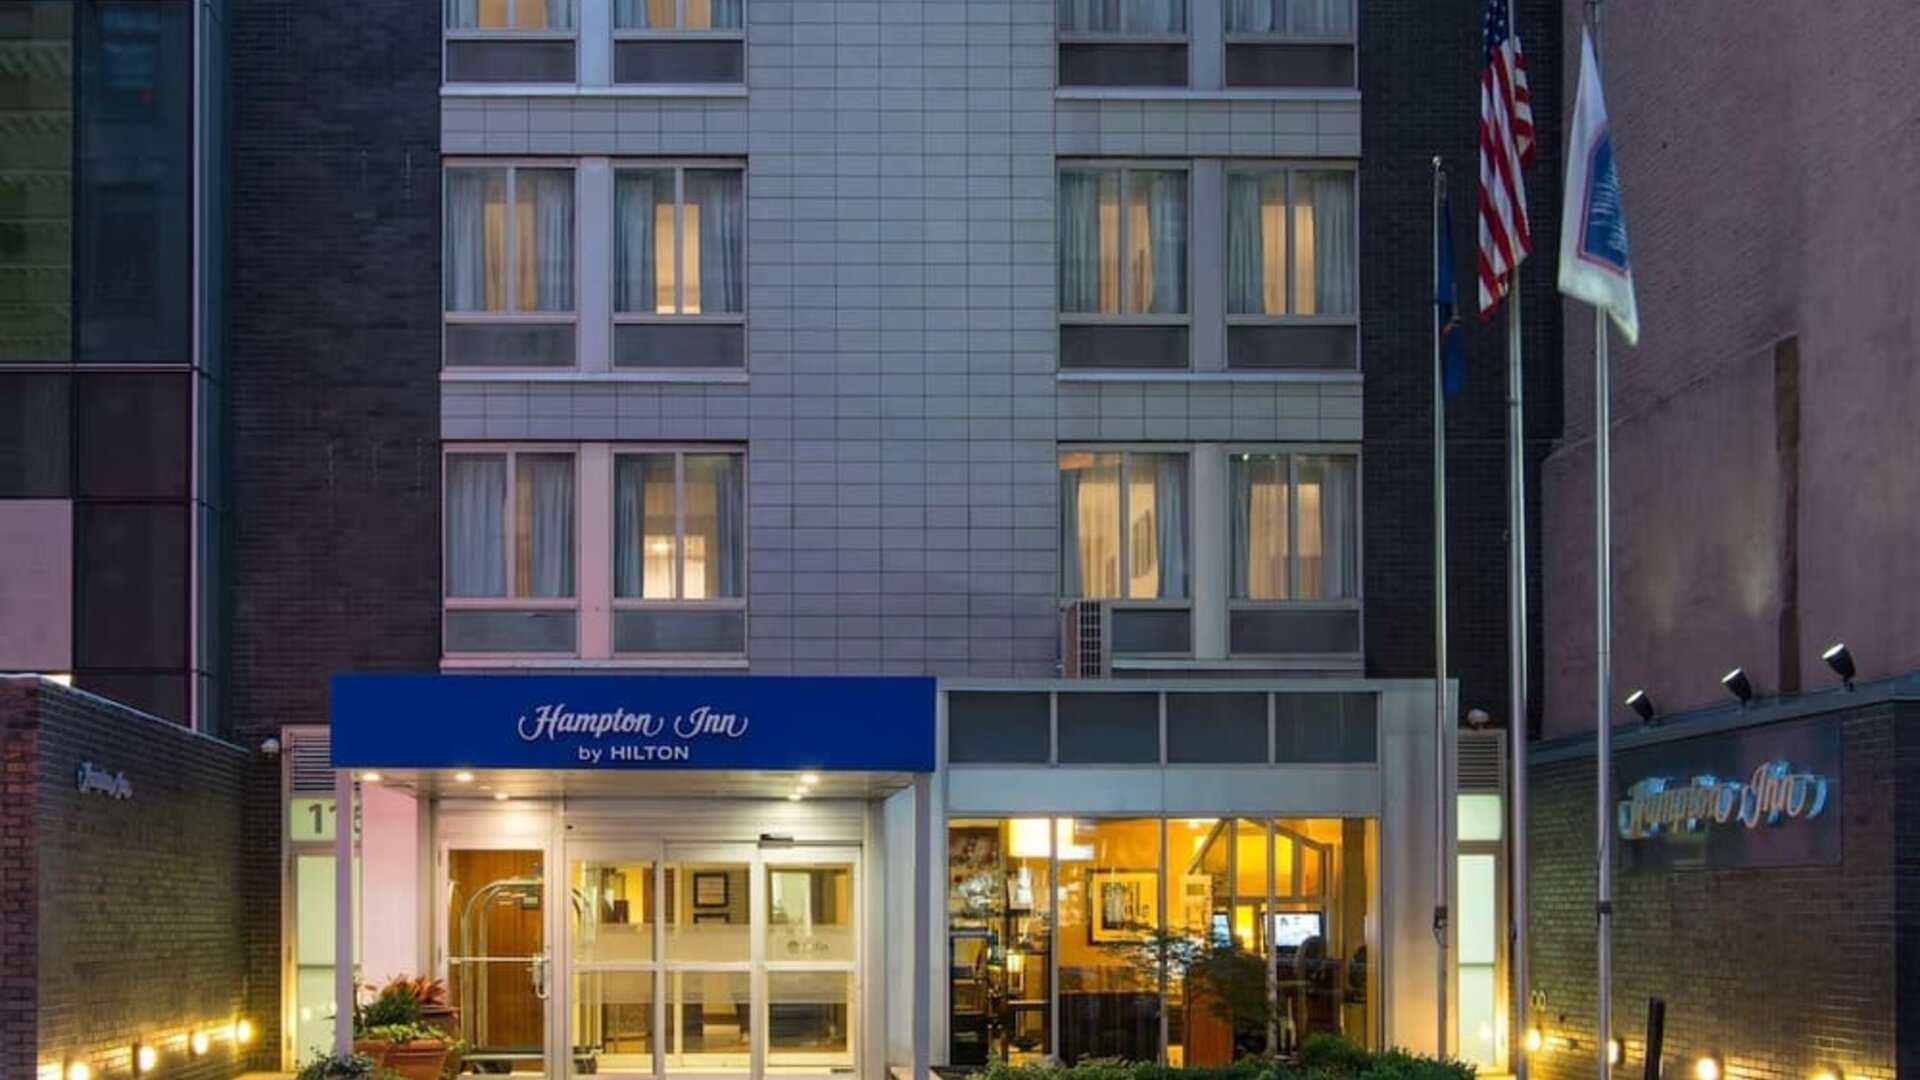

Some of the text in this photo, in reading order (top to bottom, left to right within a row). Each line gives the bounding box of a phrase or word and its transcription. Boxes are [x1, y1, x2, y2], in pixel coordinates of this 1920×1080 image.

[517, 703, 748, 741] Hampton Inn
[578, 745, 689, 763] by HILTON
